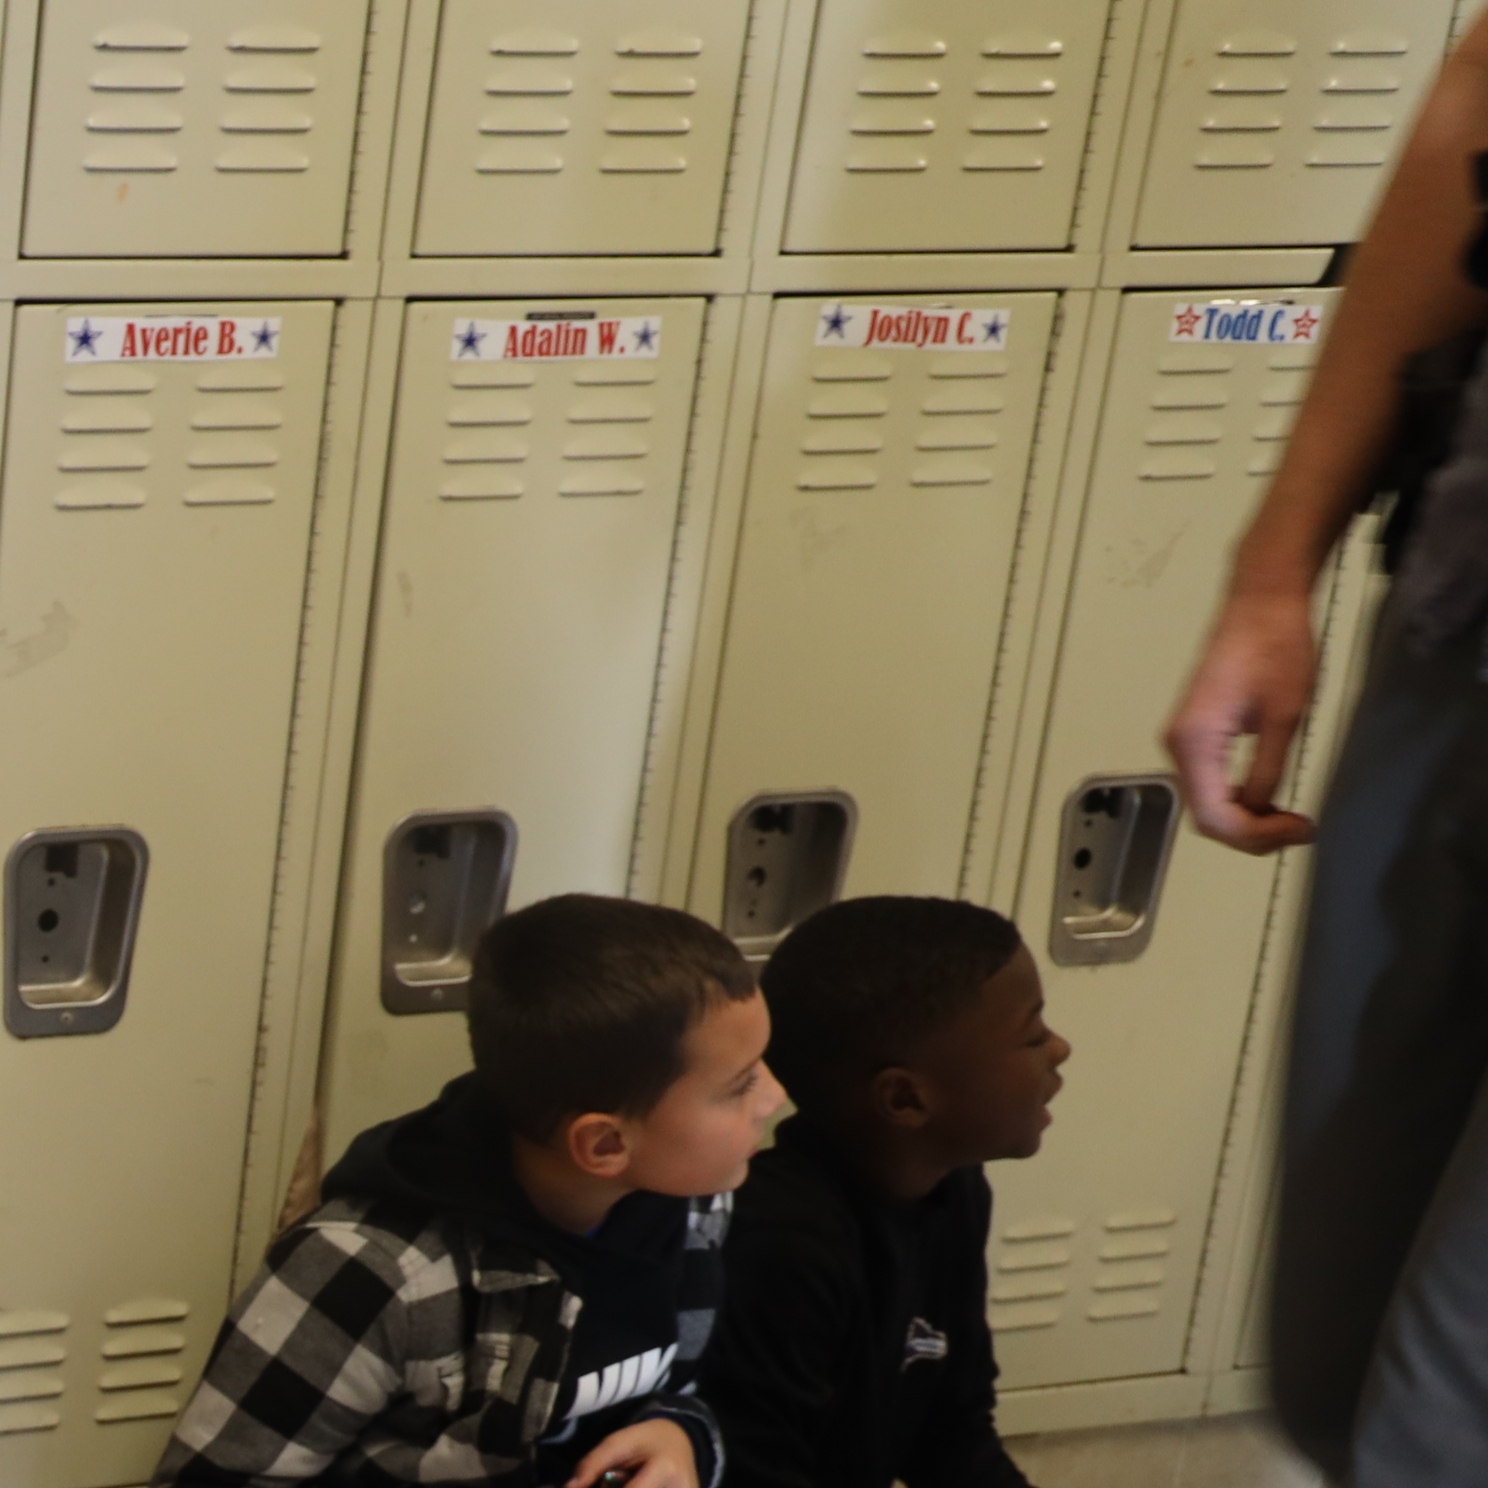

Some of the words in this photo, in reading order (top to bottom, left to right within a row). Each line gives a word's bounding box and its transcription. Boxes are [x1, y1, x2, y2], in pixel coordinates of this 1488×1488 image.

[120, 320, 209, 358] Averie
[216, 319, 243, 356] B.
[503, 320, 588, 358] Adalin
[598, 320, 626, 356] W.
[956, 310, 974, 345] C.
[1204, 307, 1265, 341] Todd
[1268, 308, 1286, 342] C.
